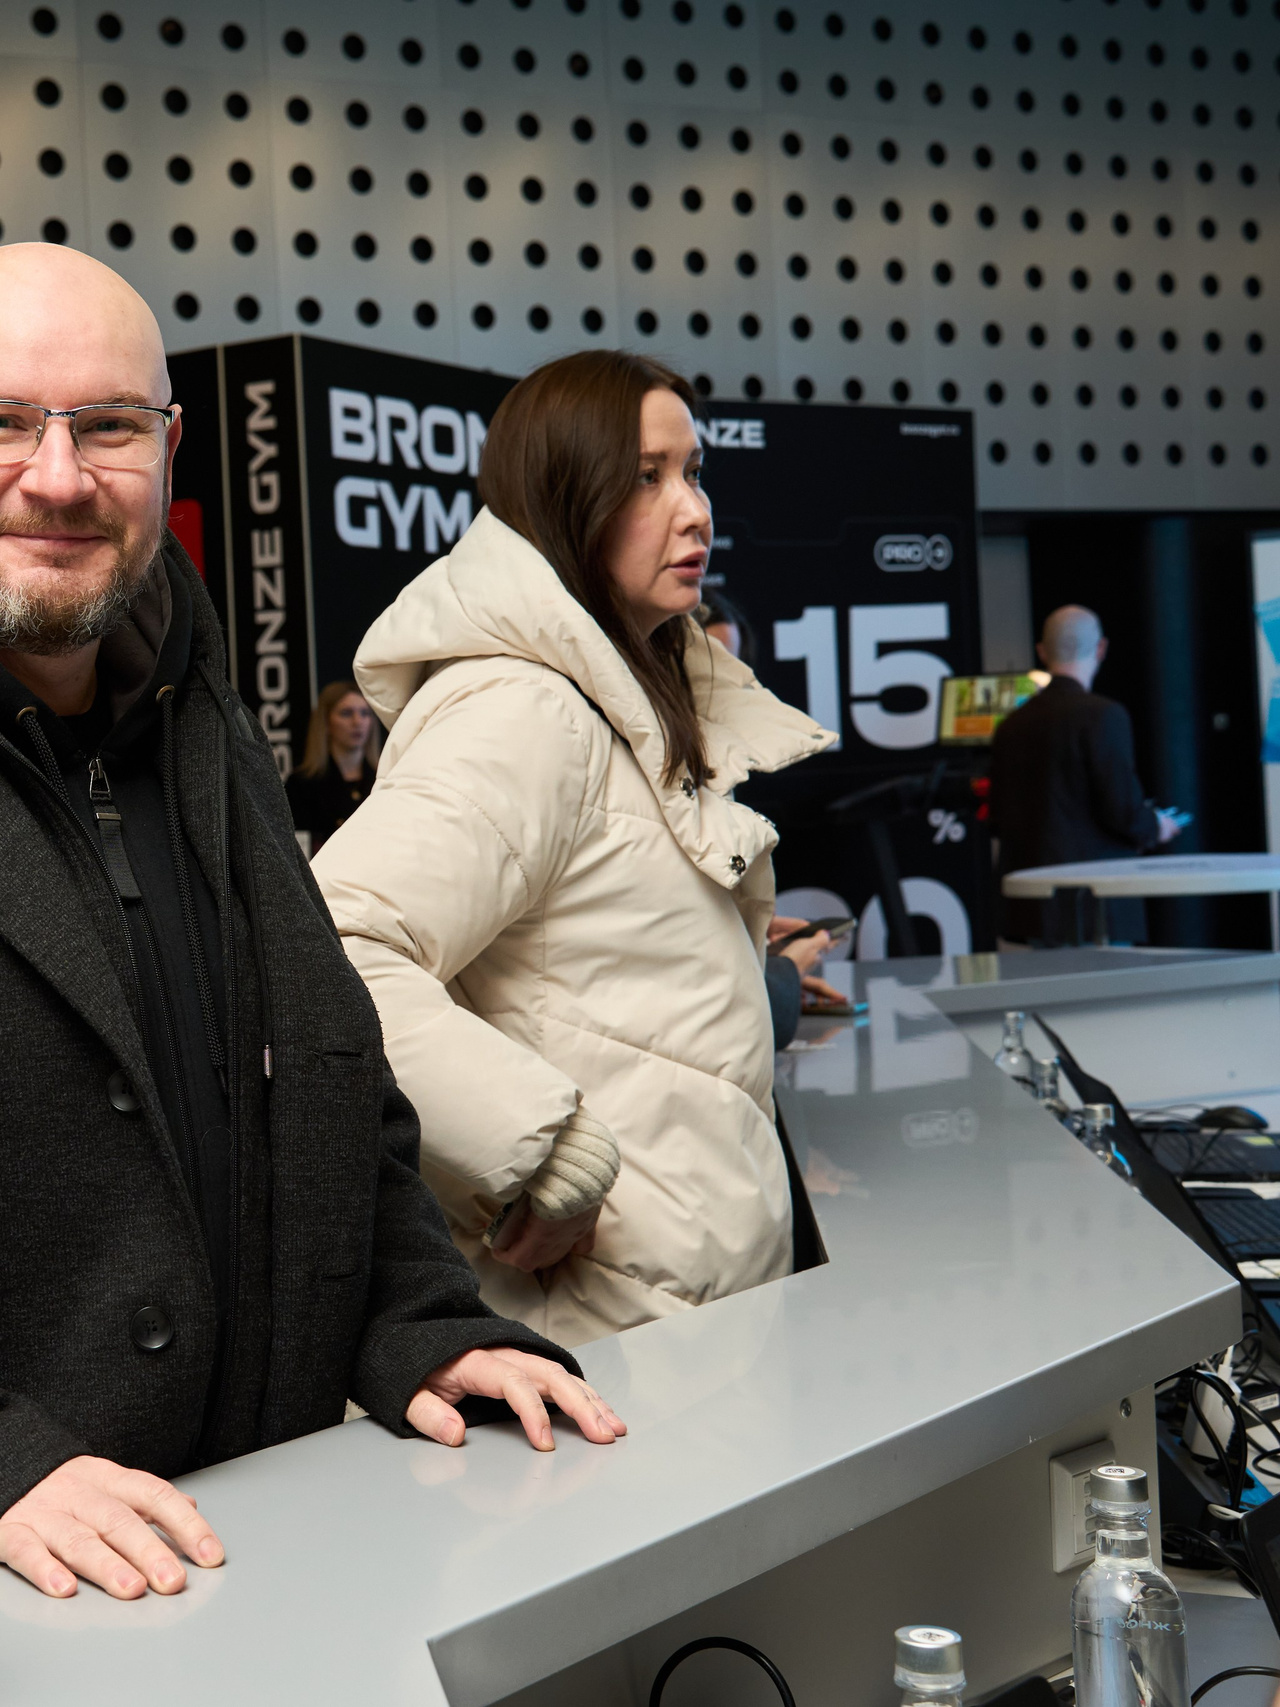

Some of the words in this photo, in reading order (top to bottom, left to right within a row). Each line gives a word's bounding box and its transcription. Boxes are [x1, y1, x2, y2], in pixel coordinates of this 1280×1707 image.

[245, 379, 281, 515] GYM
[329, 387, 488, 478] BRON
[694, 418, 766, 449] NZE
[333, 475, 472, 554] GYM
[774, 602, 954, 751] 15
